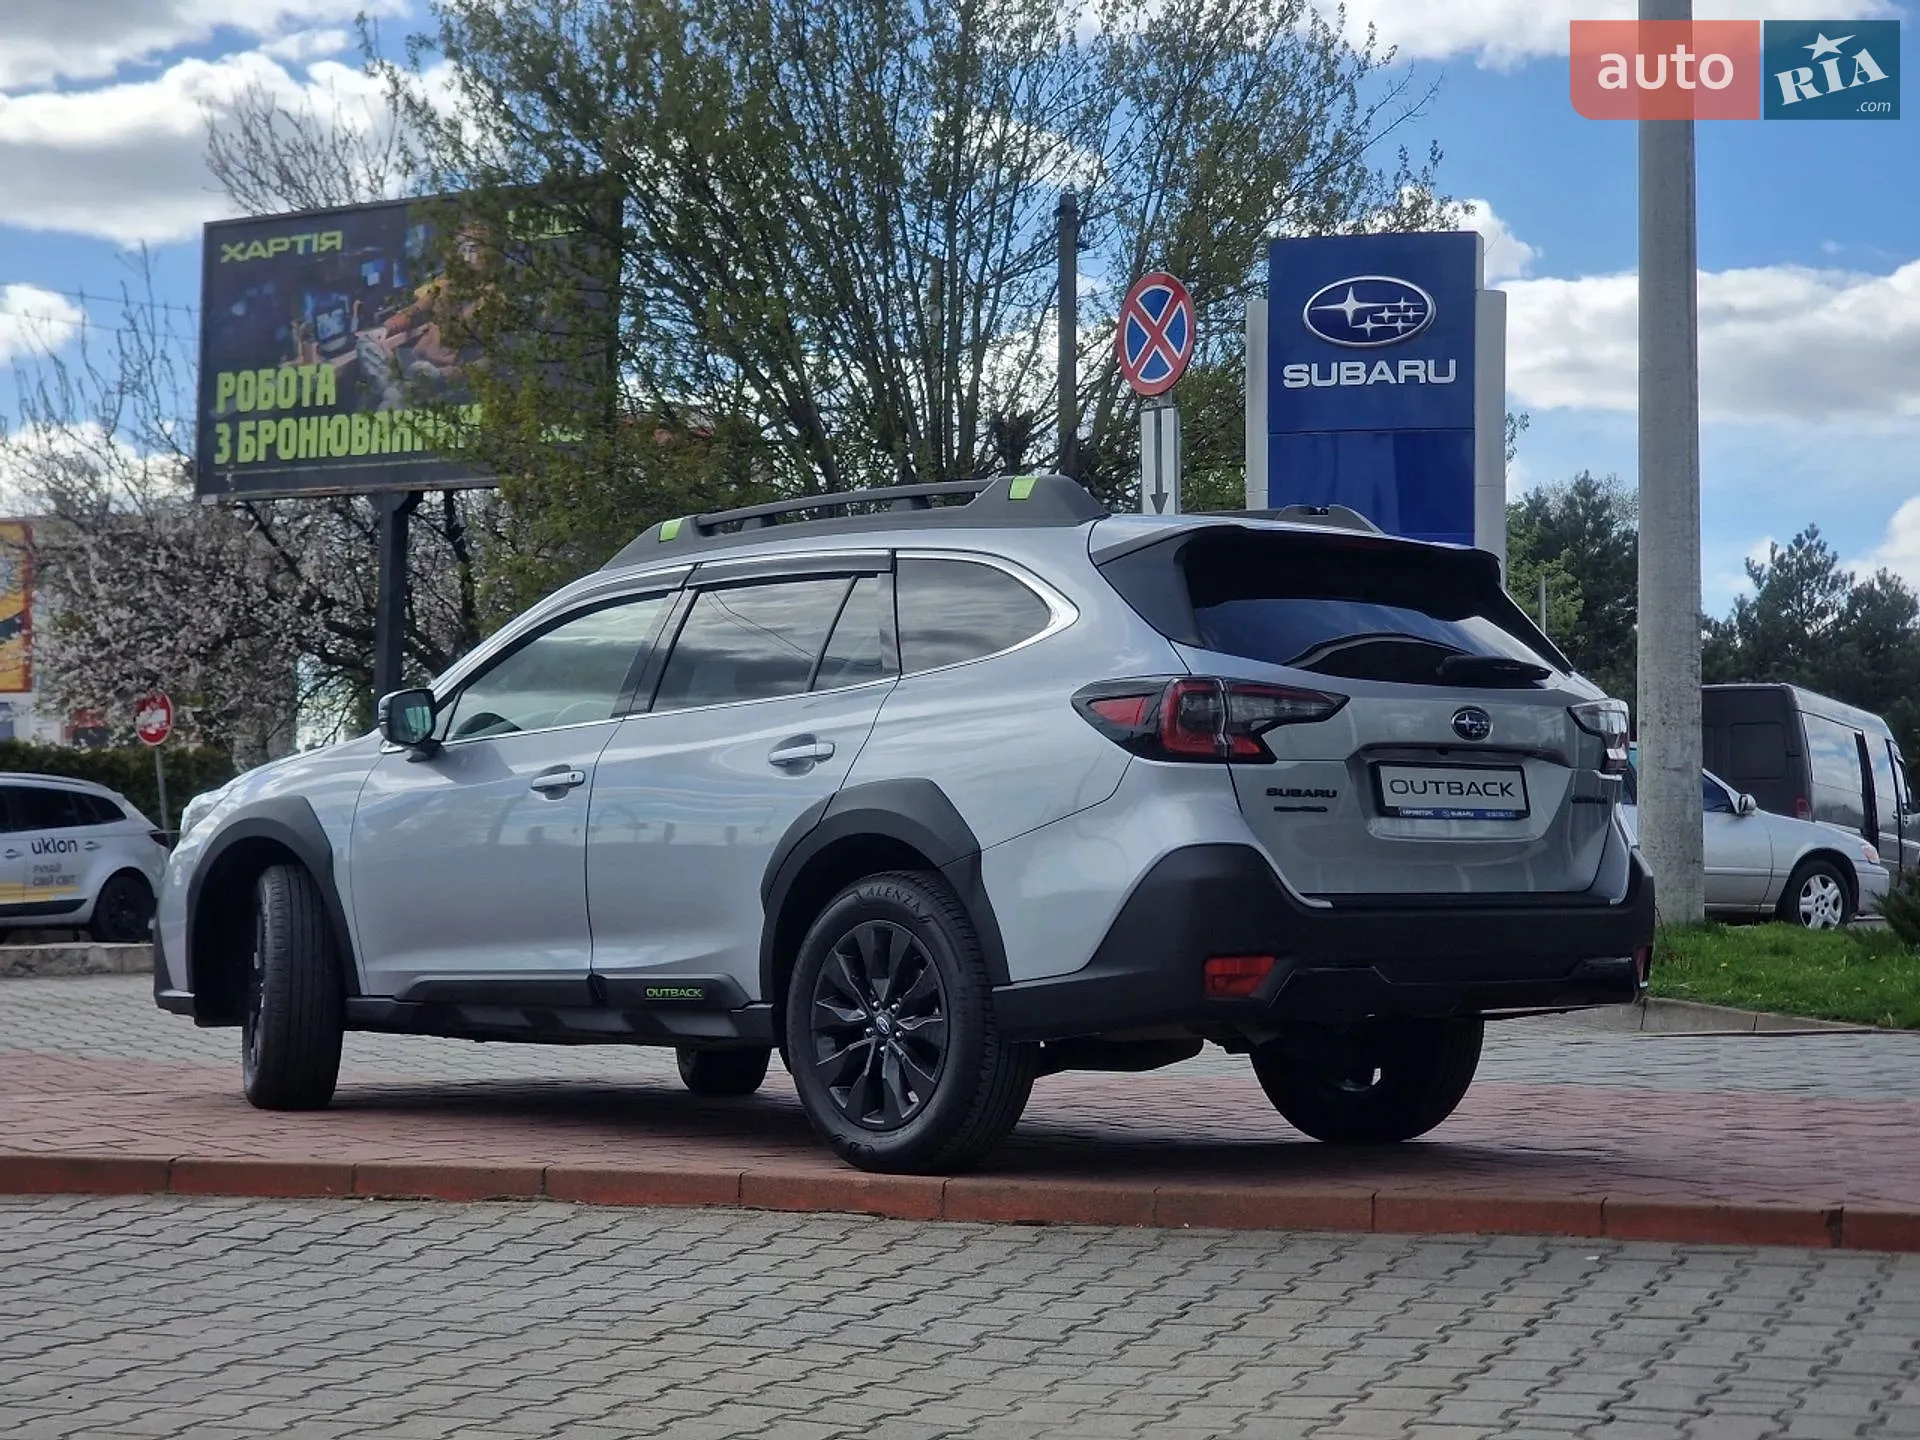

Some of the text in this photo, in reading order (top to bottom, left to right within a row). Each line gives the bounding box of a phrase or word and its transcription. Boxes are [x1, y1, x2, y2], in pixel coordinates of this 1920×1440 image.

[219, 230, 343, 264] ХАРТІЯ
[1282, 358, 1457, 389] SUBARU
[217, 365, 336, 414] РОБОТА
[214, 421, 231, 465] З
[1265, 787, 1338, 798] SUBARU
[1389, 779, 1516, 798] OUTBACK
[31, 837, 78, 855] uklon
[646, 988, 702, 997] OUTBACK
